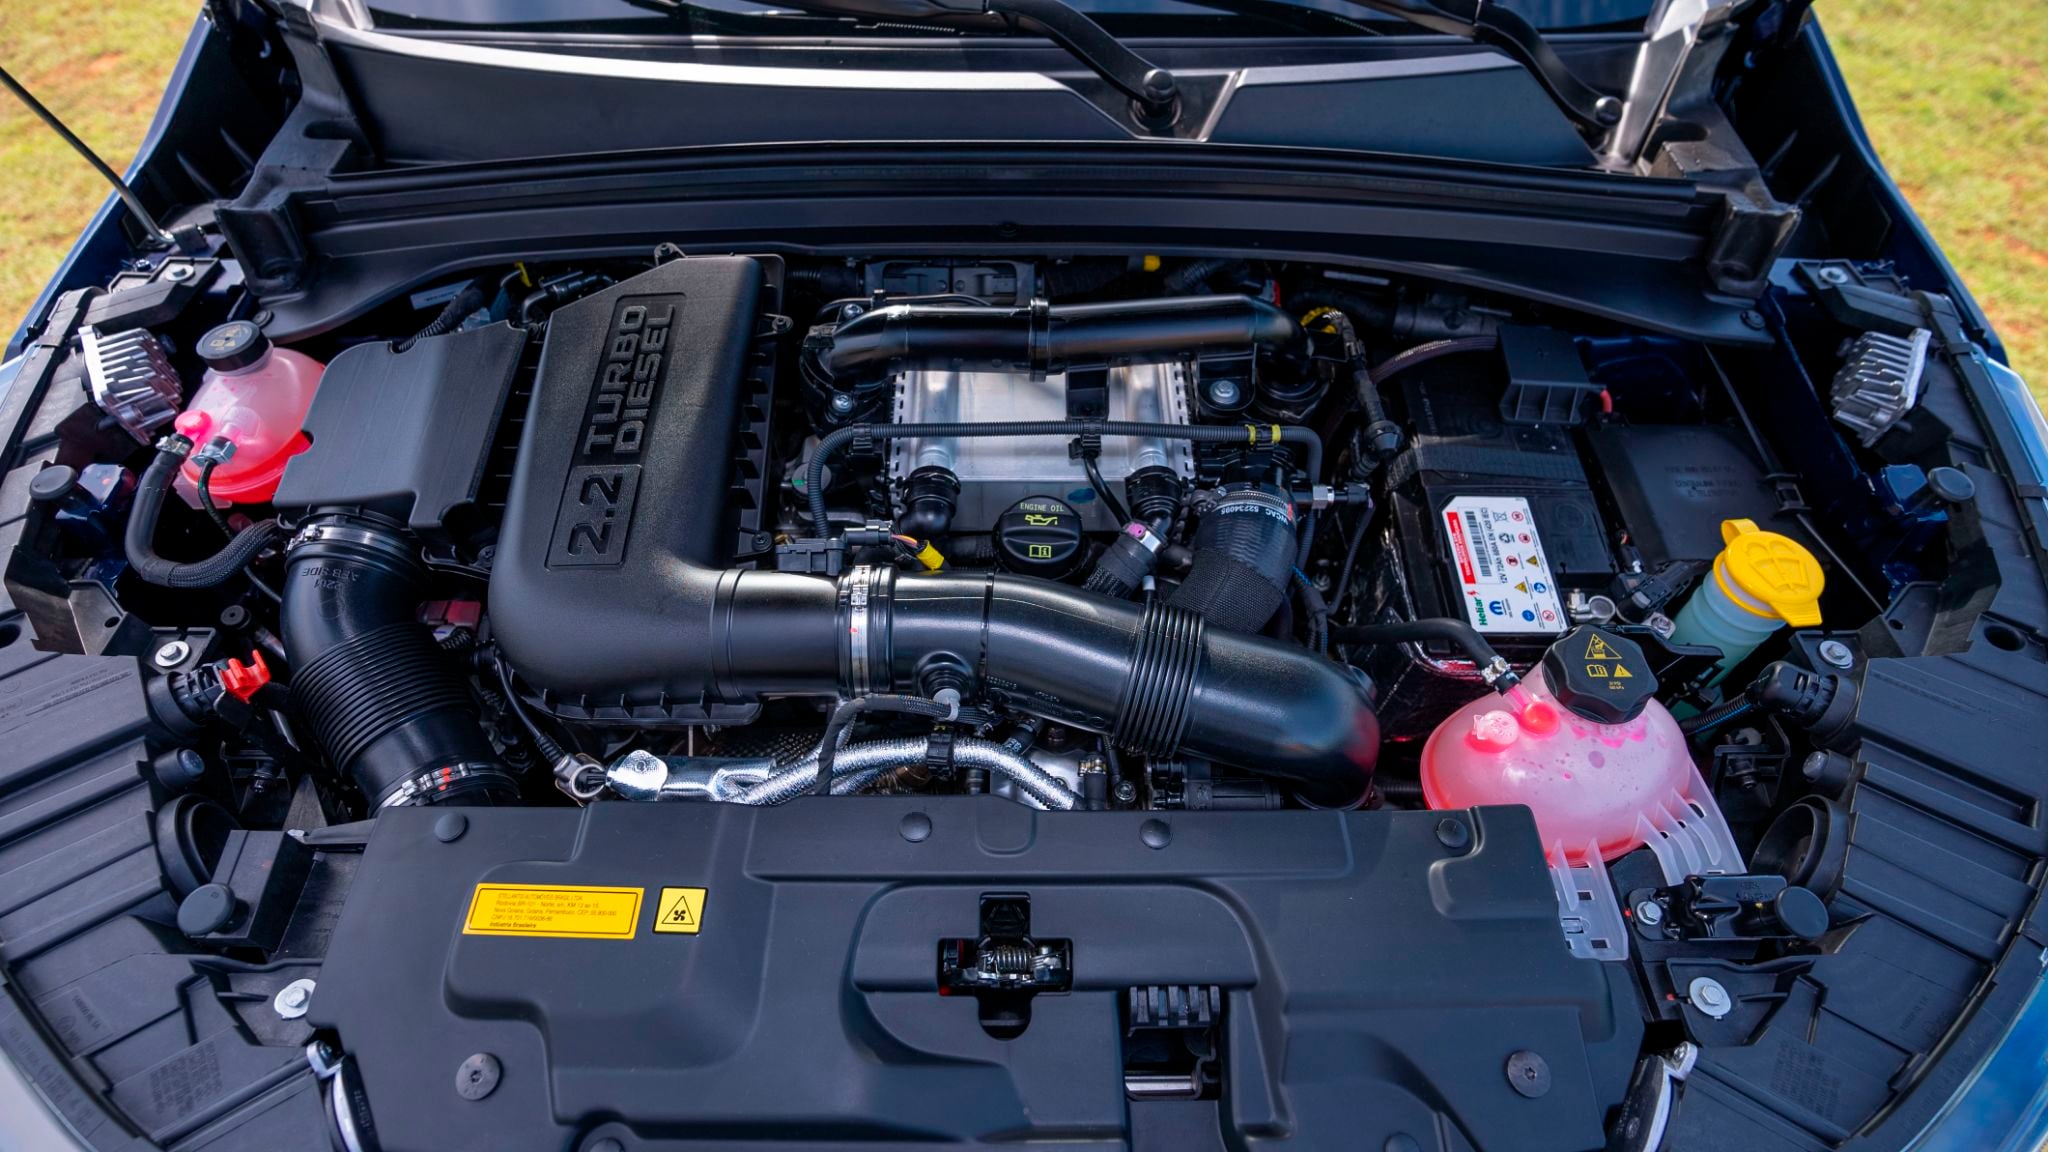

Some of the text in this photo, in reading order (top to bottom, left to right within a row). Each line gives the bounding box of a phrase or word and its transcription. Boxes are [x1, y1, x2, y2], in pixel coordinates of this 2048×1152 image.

[584, 305, 648, 454] TURBO
[614, 304, 674, 453] DIESEL
[567, 472, 624, 556] 2.2
[1020, 502, 1064, 512] ENGINE OIL
[1500, 573, 1508, 583] 12V
[1474, 597, 1488, 625] Heliar
